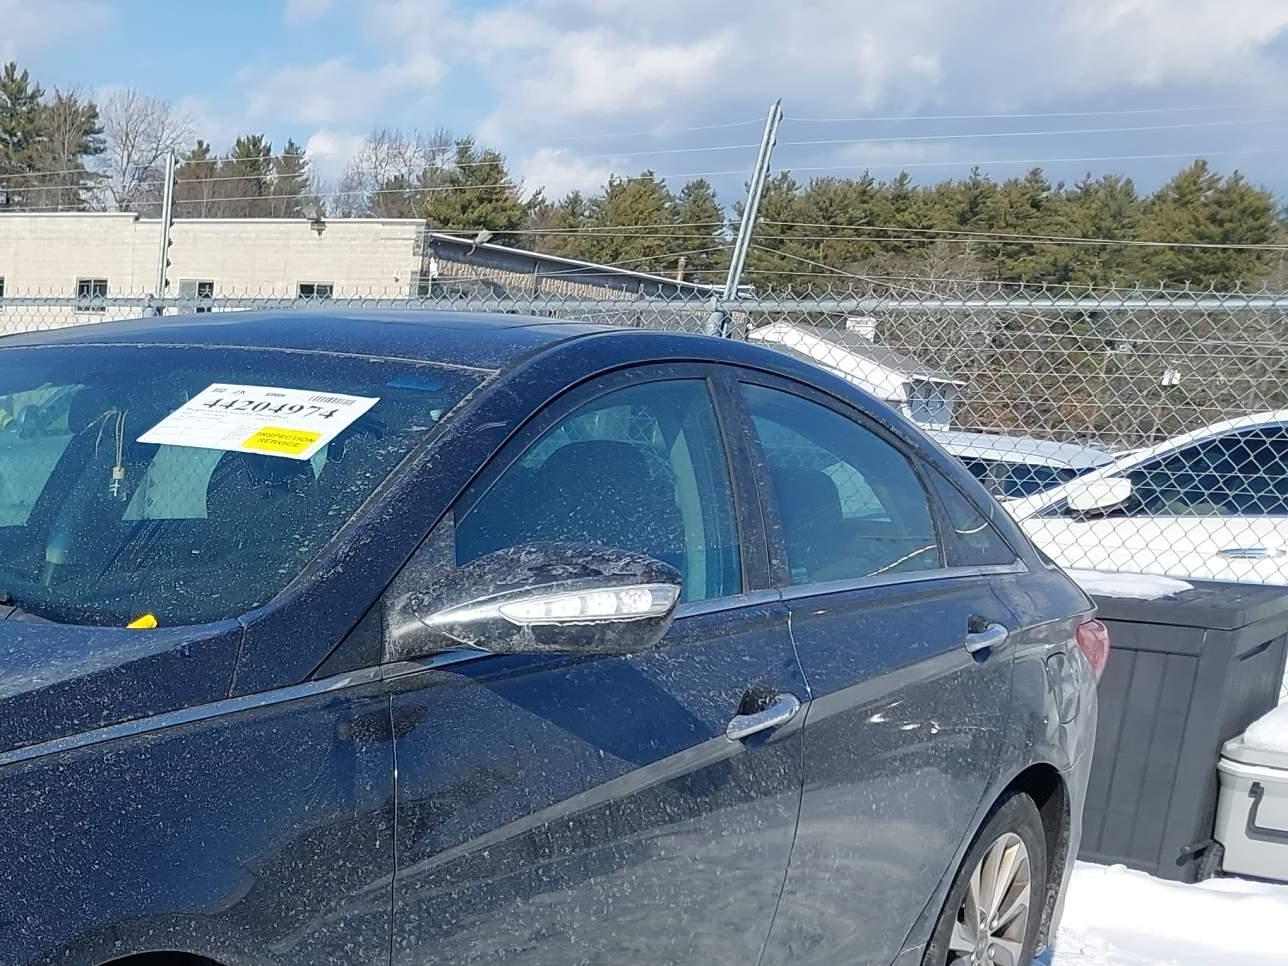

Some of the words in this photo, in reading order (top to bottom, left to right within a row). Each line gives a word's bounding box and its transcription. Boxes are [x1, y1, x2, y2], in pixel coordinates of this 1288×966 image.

[203, 397, 340, 419] 44204974
[256, 431, 316, 444] INSPECTION
[256, 438, 302, 448] SERVICE
